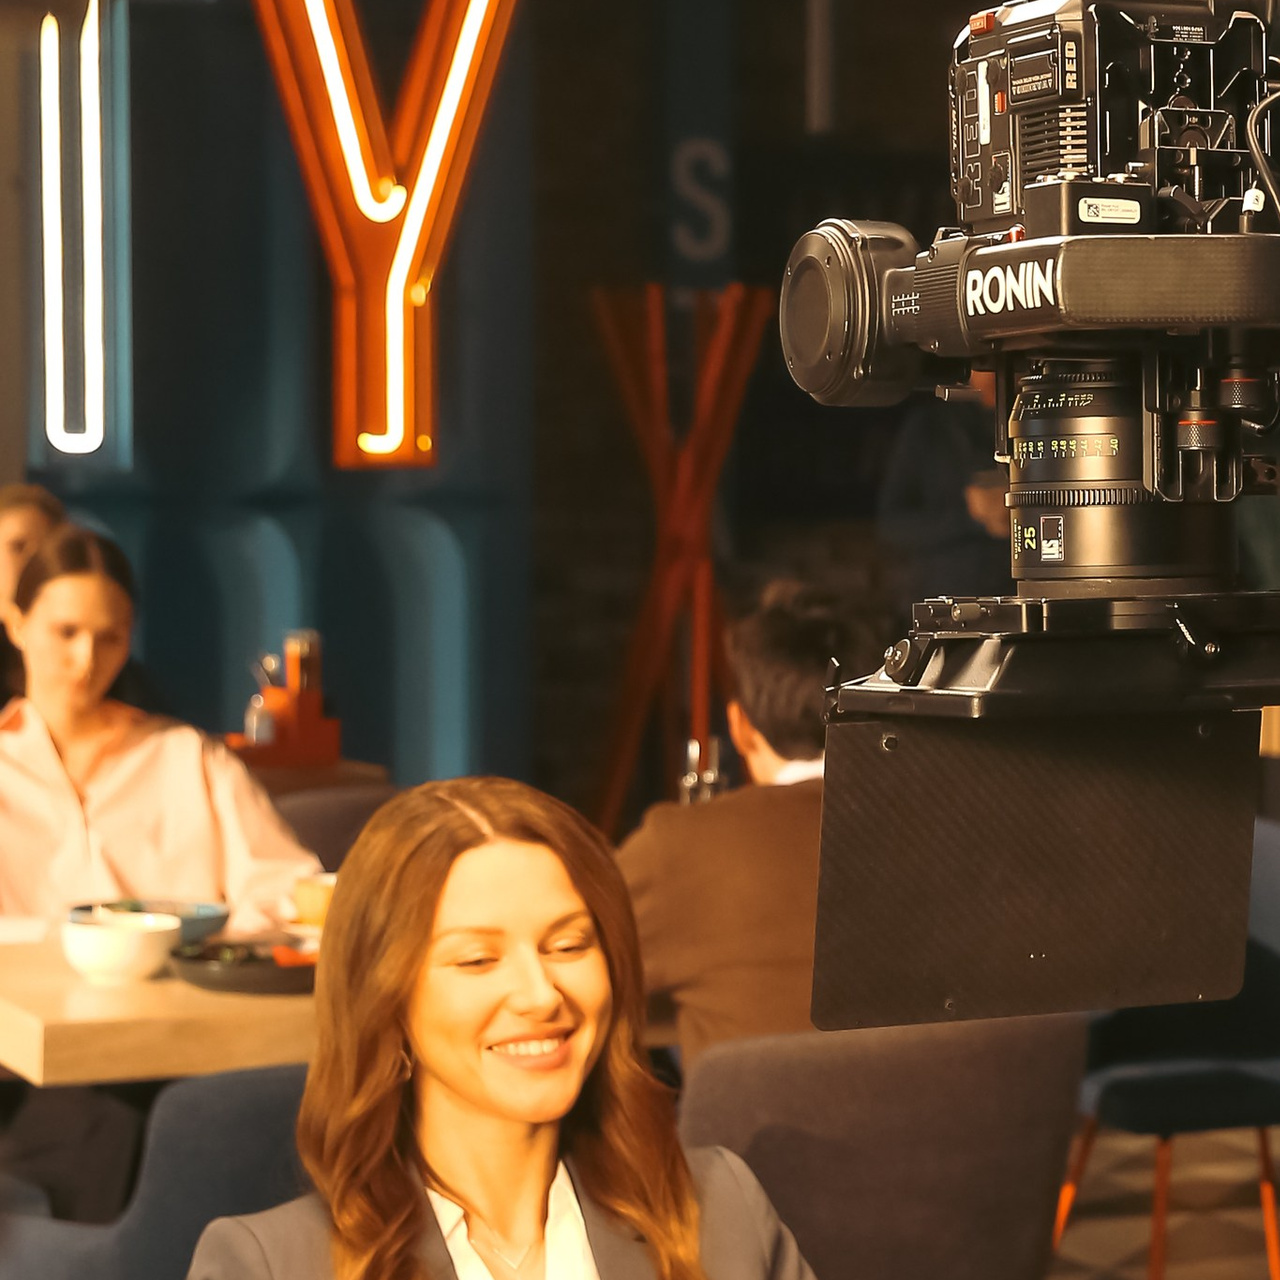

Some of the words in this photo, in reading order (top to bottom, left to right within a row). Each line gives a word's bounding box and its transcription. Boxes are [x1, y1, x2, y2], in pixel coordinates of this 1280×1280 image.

[1065, 41, 1077, 89] RED
[966, 258, 1055, 317] RONIN
[1023, 526, 1037, 550] 25
